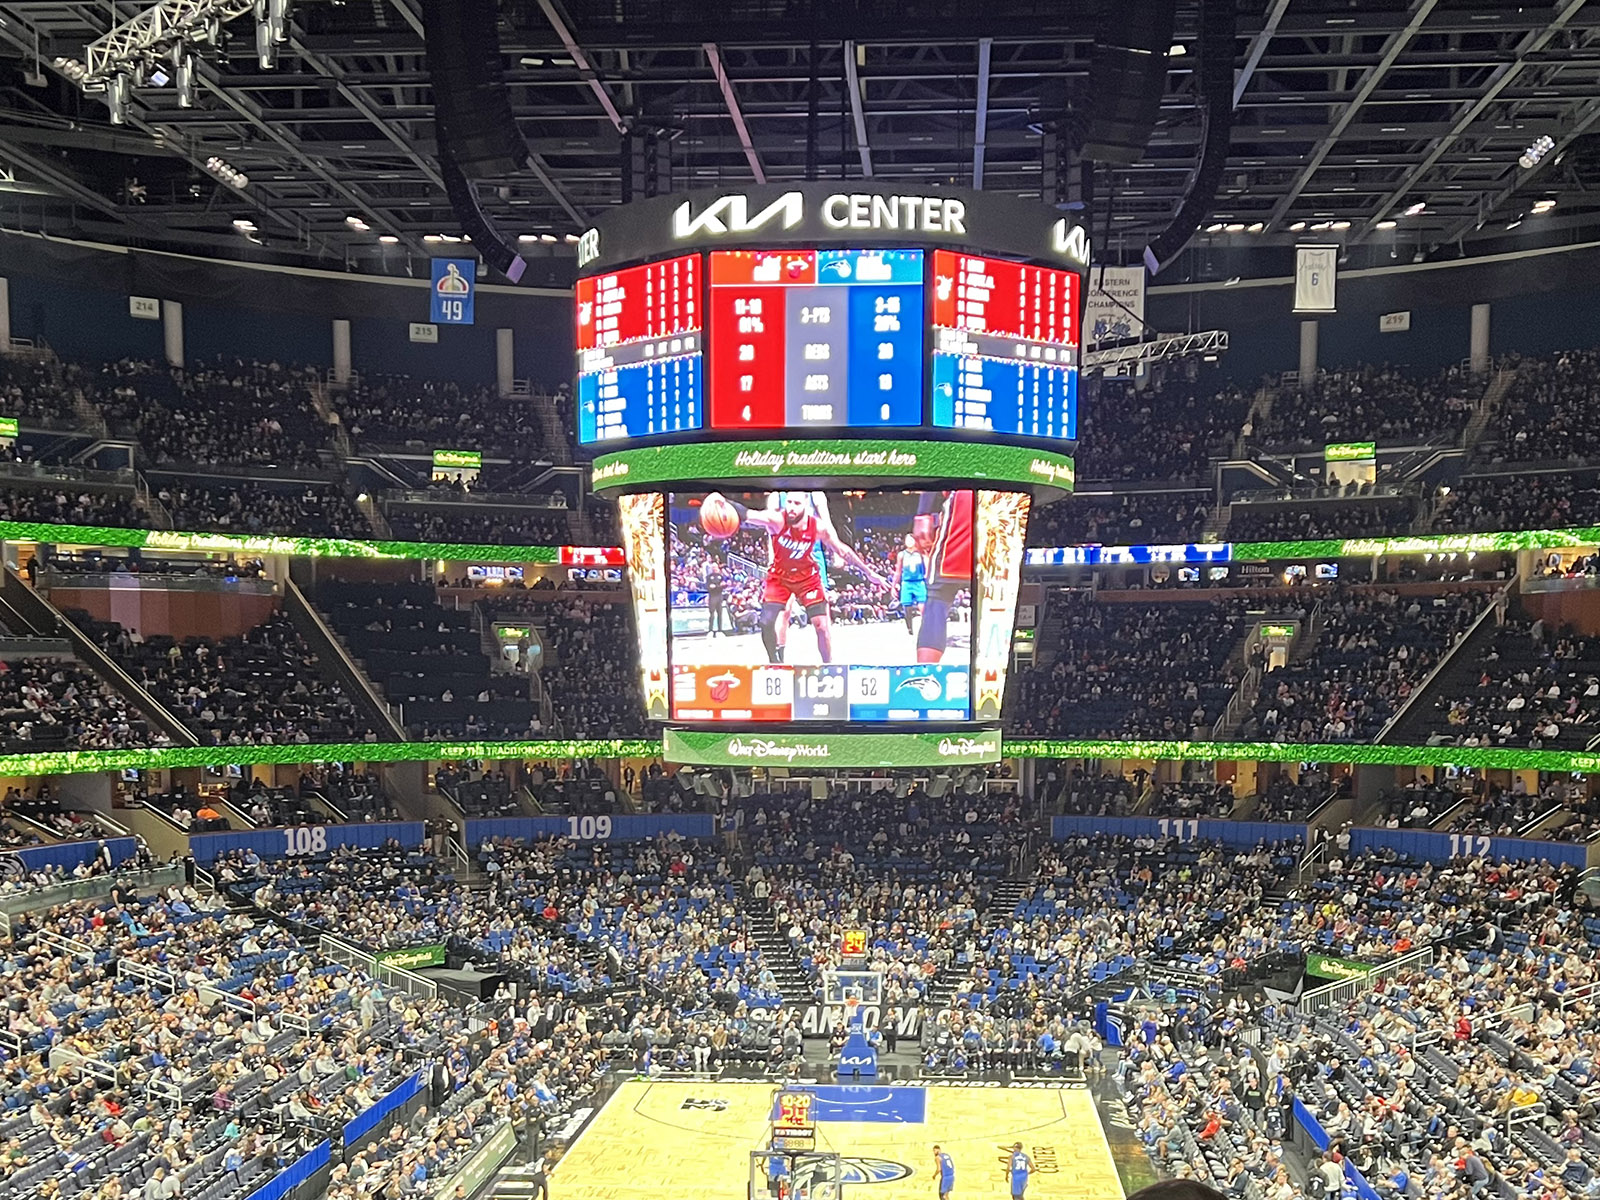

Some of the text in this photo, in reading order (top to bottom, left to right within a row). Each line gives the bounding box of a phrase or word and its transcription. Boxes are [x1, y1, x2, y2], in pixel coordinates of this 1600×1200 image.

[823, 194, 966, 233] CENTER
[1311, 272, 1319, 286] 6
[442, 300, 462, 320] 49
[1385, 315, 1404, 325] 219
[414, 327, 432, 336] 215
[735, 449, 917, 473] Holiday traditions start here
[1342, 538, 1385, 556] Holiday
[1241, 565, 1270, 574] Hilton
[766, 677, 781, 696] 68
[861, 678, 877, 696] 52
[440, 746, 465, 756] KEEP
[466, 746, 485, 756] THE
[486, 746, 541, 756] TRADITIONS
[1003, 745, 1027, 754] KEEP
[1029, 745, 1048, 754] THE
[1049, 745, 1104, 755] TRADITIONS
[1571, 757, 1596, 768] KEEP
[567, 815, 612, 839] 109
[1158, 818, 1198, 844] 111
[284, 826, 327, 854] 108
[1449, 834, 1491, 860] 112
[846, 939, 866, 951] 24
[890, 1079, 1001, 1088] ORLANDO
